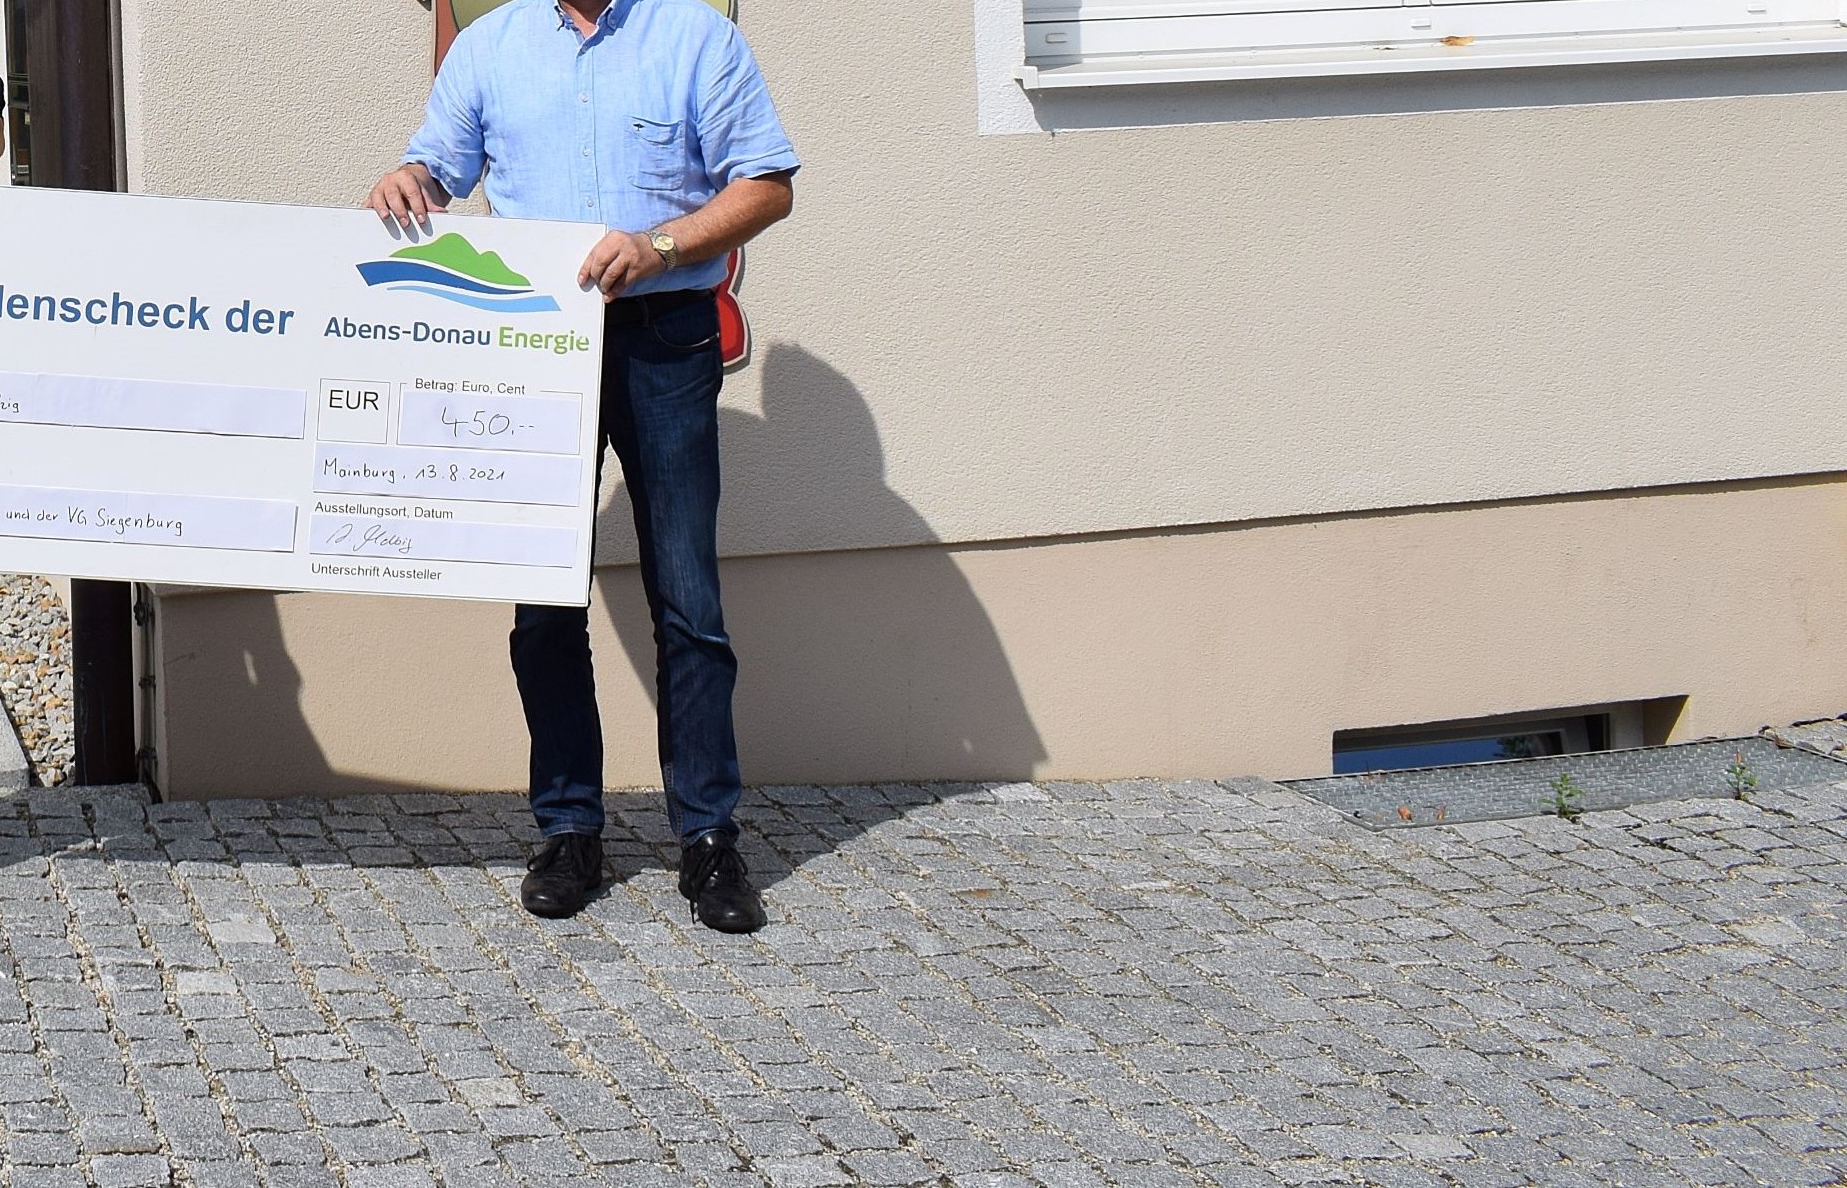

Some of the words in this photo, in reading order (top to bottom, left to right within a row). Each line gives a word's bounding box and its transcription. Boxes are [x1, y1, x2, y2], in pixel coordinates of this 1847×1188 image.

[224, 299, 295, 336] der
[323, 316, 492, 346] Abens-Donau
[498, 326, 590, 355] Energie
[414, 378, 458, 394] Betrag:
[462, 380, 493, 395] Euro,
[497, 383, 526, 395] Cent
[328, 389, 380, 411] EUR
[5, 508, 30, 521] und
[36, 509, 59, 522] der
[67, 506, 88, 526] VG
[95, 507, 183, 537] Siegenburg
[314, 501, 411, 519] Ausstellungsort,
[414, 507, 453, 520] Datum
[311, 563, 380, 578] Unterschrift
[382, 567, 442, 581] Aussteller
